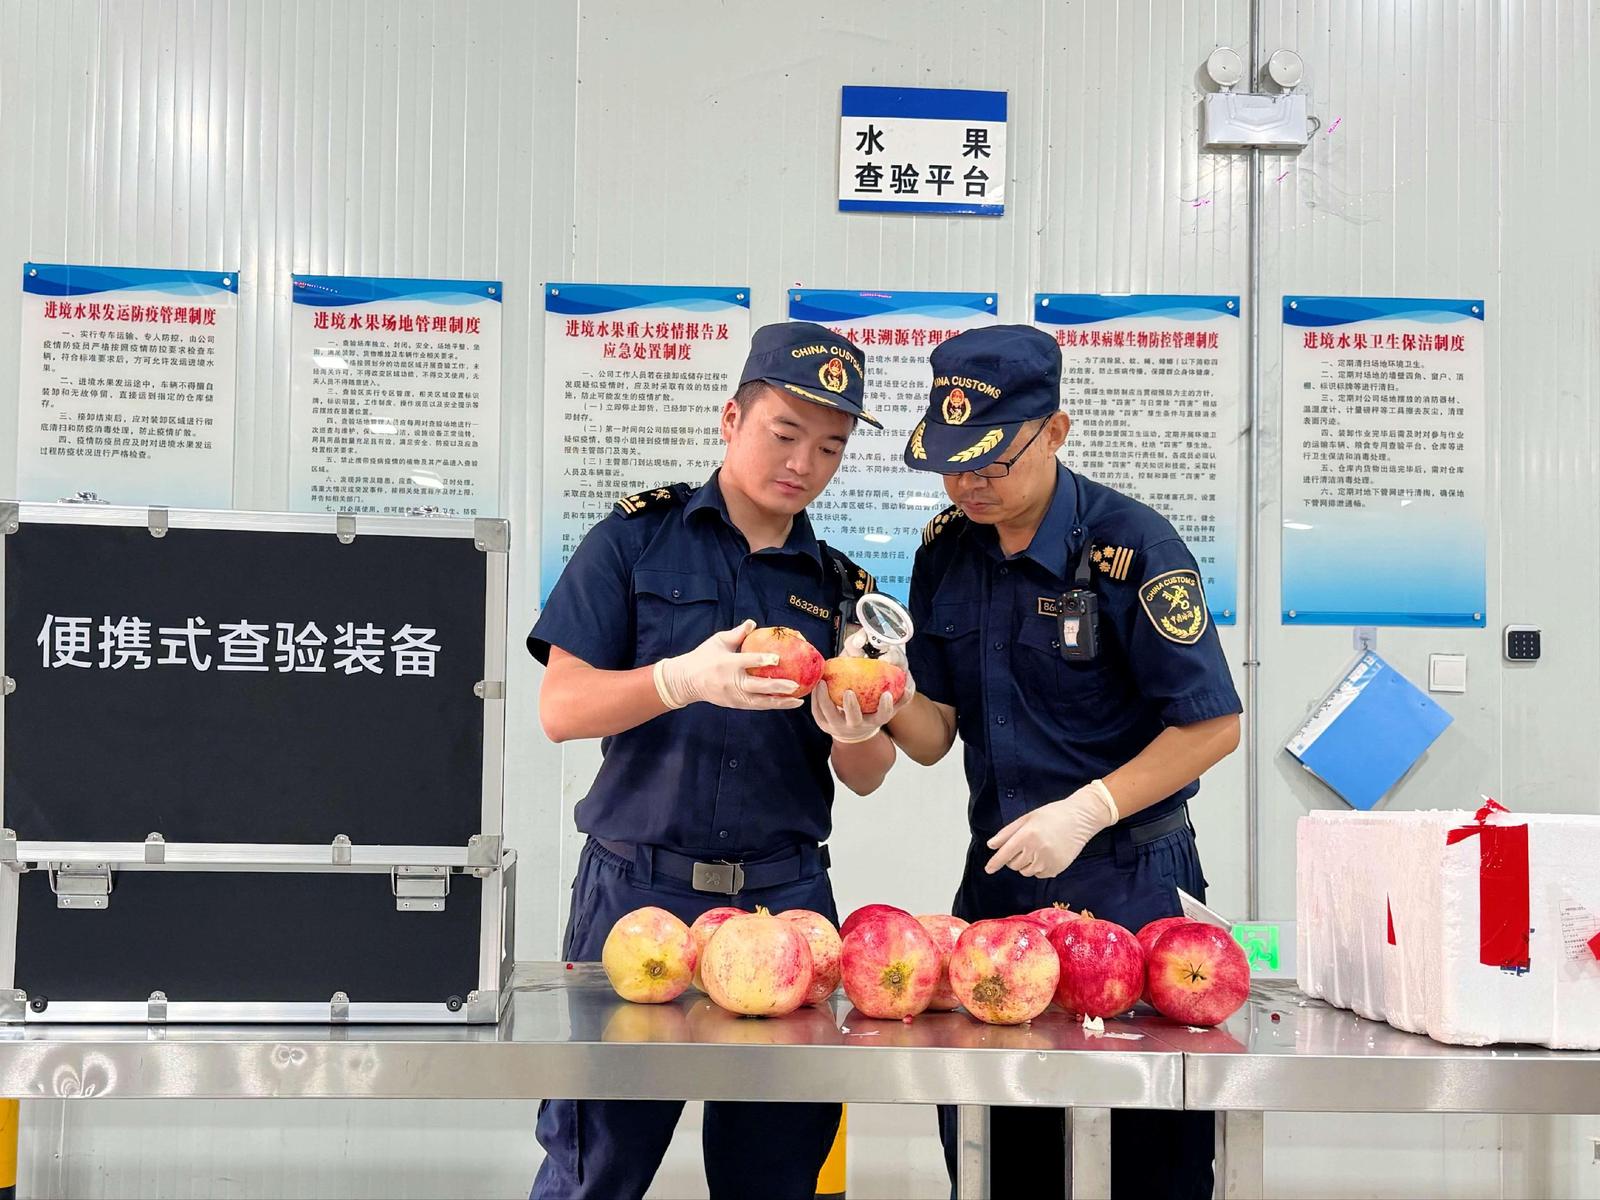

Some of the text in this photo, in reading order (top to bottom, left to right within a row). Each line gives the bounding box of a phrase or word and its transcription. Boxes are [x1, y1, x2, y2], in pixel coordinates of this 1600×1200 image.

[854, 162, 989, 197] 查验平台
[45, 302, 216, 325] 进境水果发运防疫管理制度
[314, 312, 480, 334] 进境水果场地管理制度
[566, 320, 728, 340] 进境水果重大疫情报告及
[1056, 330, 1219, 348] 进境水果病媒生物防控管理制度
[603, 342, 692, 360] 应急处置制度
[792, 345, 828, 358] CHINA
[1304, 332, 1465, 352] 进境水果卫生保洁制度
[952, 376, 1001, 399] CUSTOMS
[1146, 577, 1196, 601] CHINA CUSTOMS
[789, 595, 829, 619] 8632810
[1044, 602, 1056, 611] 86
[37, 613, 442, 677] 便携式查验装备
